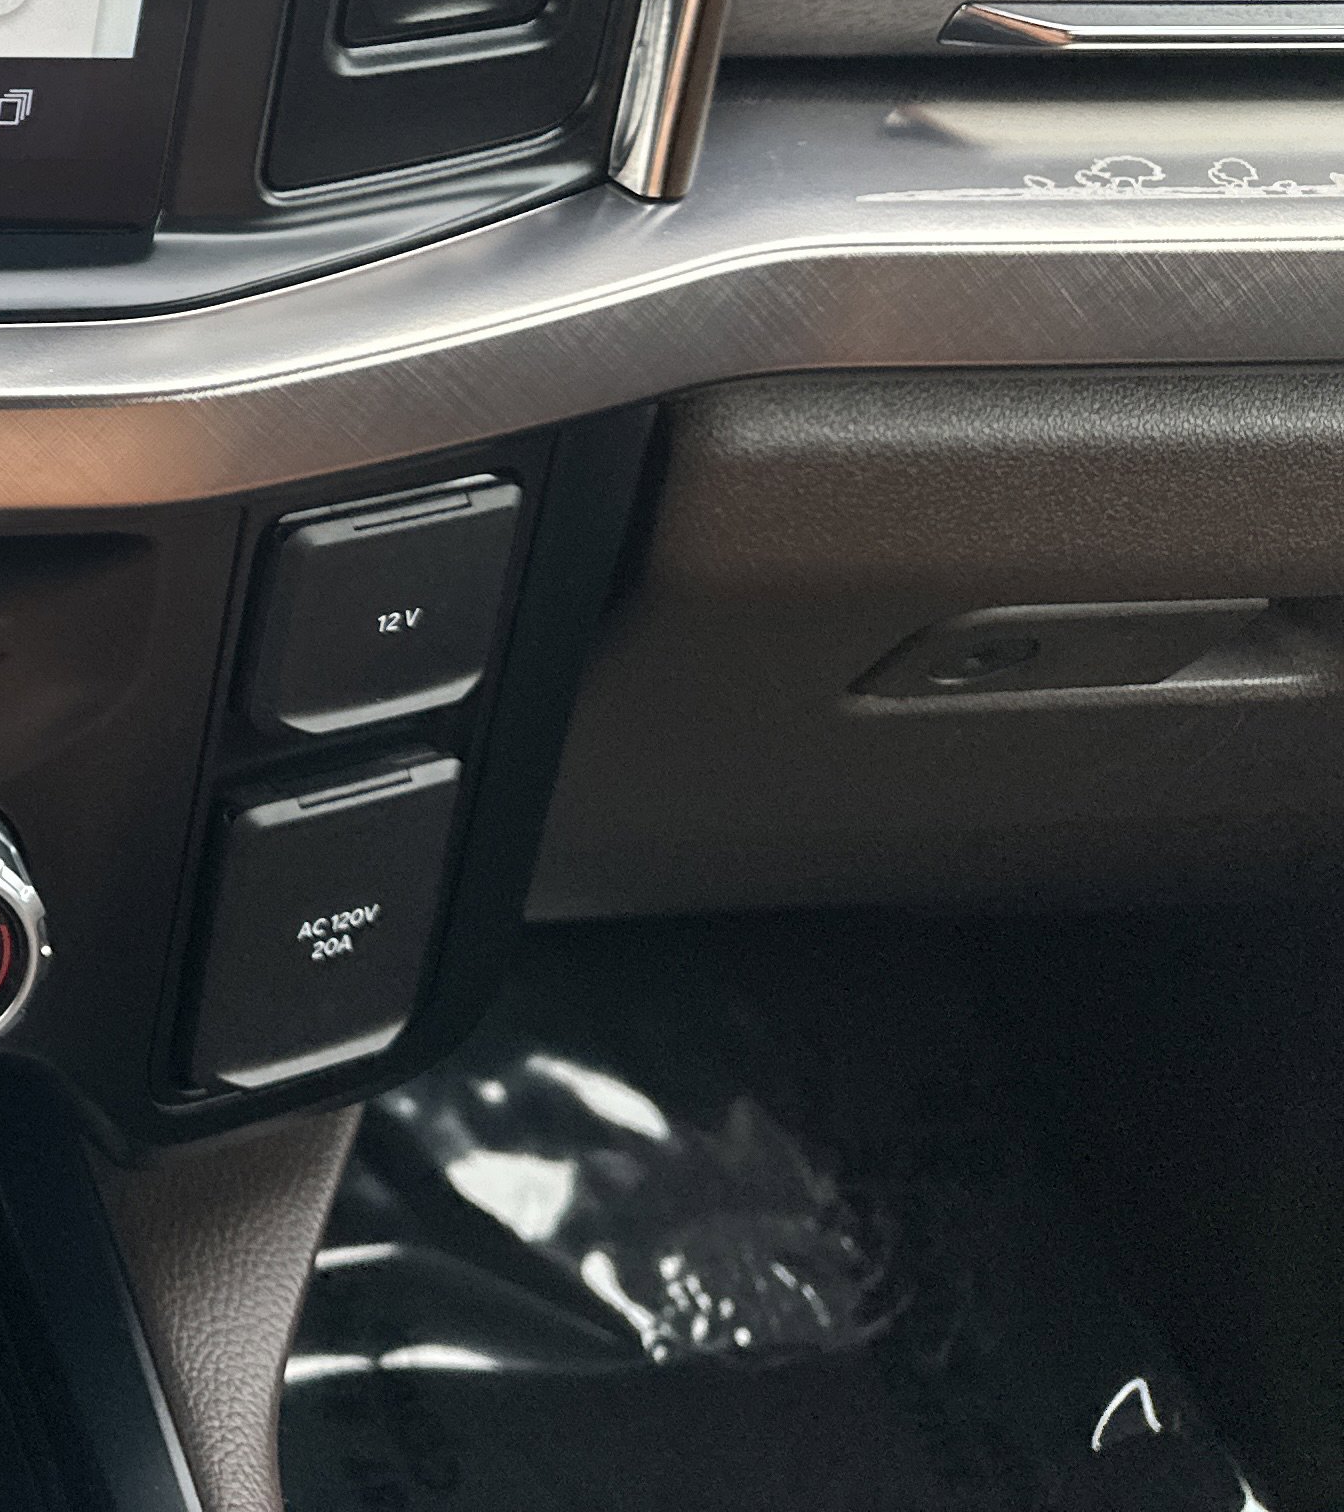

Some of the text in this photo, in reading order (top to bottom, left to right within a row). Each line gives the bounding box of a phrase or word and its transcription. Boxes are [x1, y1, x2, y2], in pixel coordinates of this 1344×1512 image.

[377, 607, 421, 633] 12 V
[297, 903, 380, 940] AC 120V
[311, 934, 353, 961] 20A
